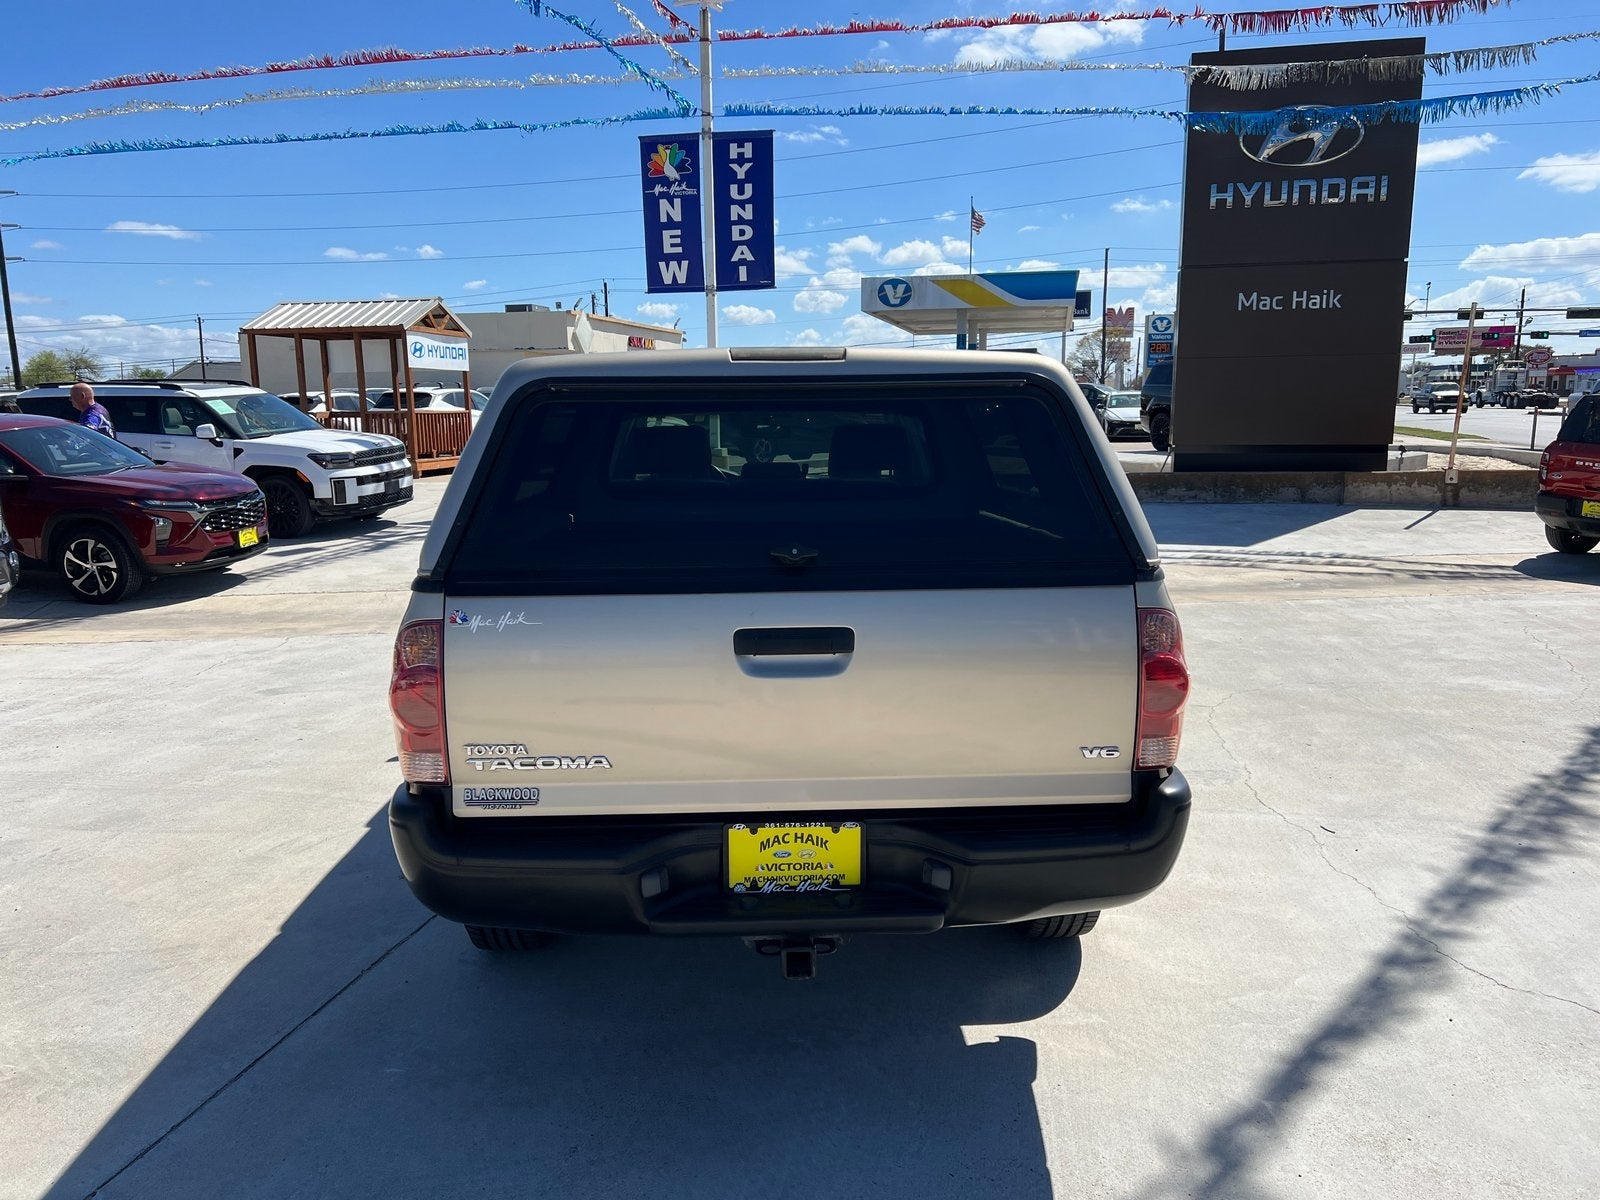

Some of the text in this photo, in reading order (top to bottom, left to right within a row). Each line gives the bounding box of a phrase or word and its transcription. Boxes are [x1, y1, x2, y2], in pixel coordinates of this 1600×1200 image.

[1209, 175, 1389, 209] HYUNDAI
[729, 142, 755, 282] HYUNDAI
[658, 198, 689, 285] NEW
[1237, 289, 1342, 311] Mac Haik
[427, 343, 467, 361] HYUNDAI
[468, 611, 532, 633] Mac Haik
[464, 743, 528, 756] TOYOTA
[1080, 745, 1120, 759] V6
[465, 755, 613, 771] TACOMA
[464, 787, 540, 801] BLACKWOOD
[759, 832, 829, 853] MAC HAIK
[765, 862, 824, 872] VICTORIA
[760, 880, 834, 893] Mac Haik
